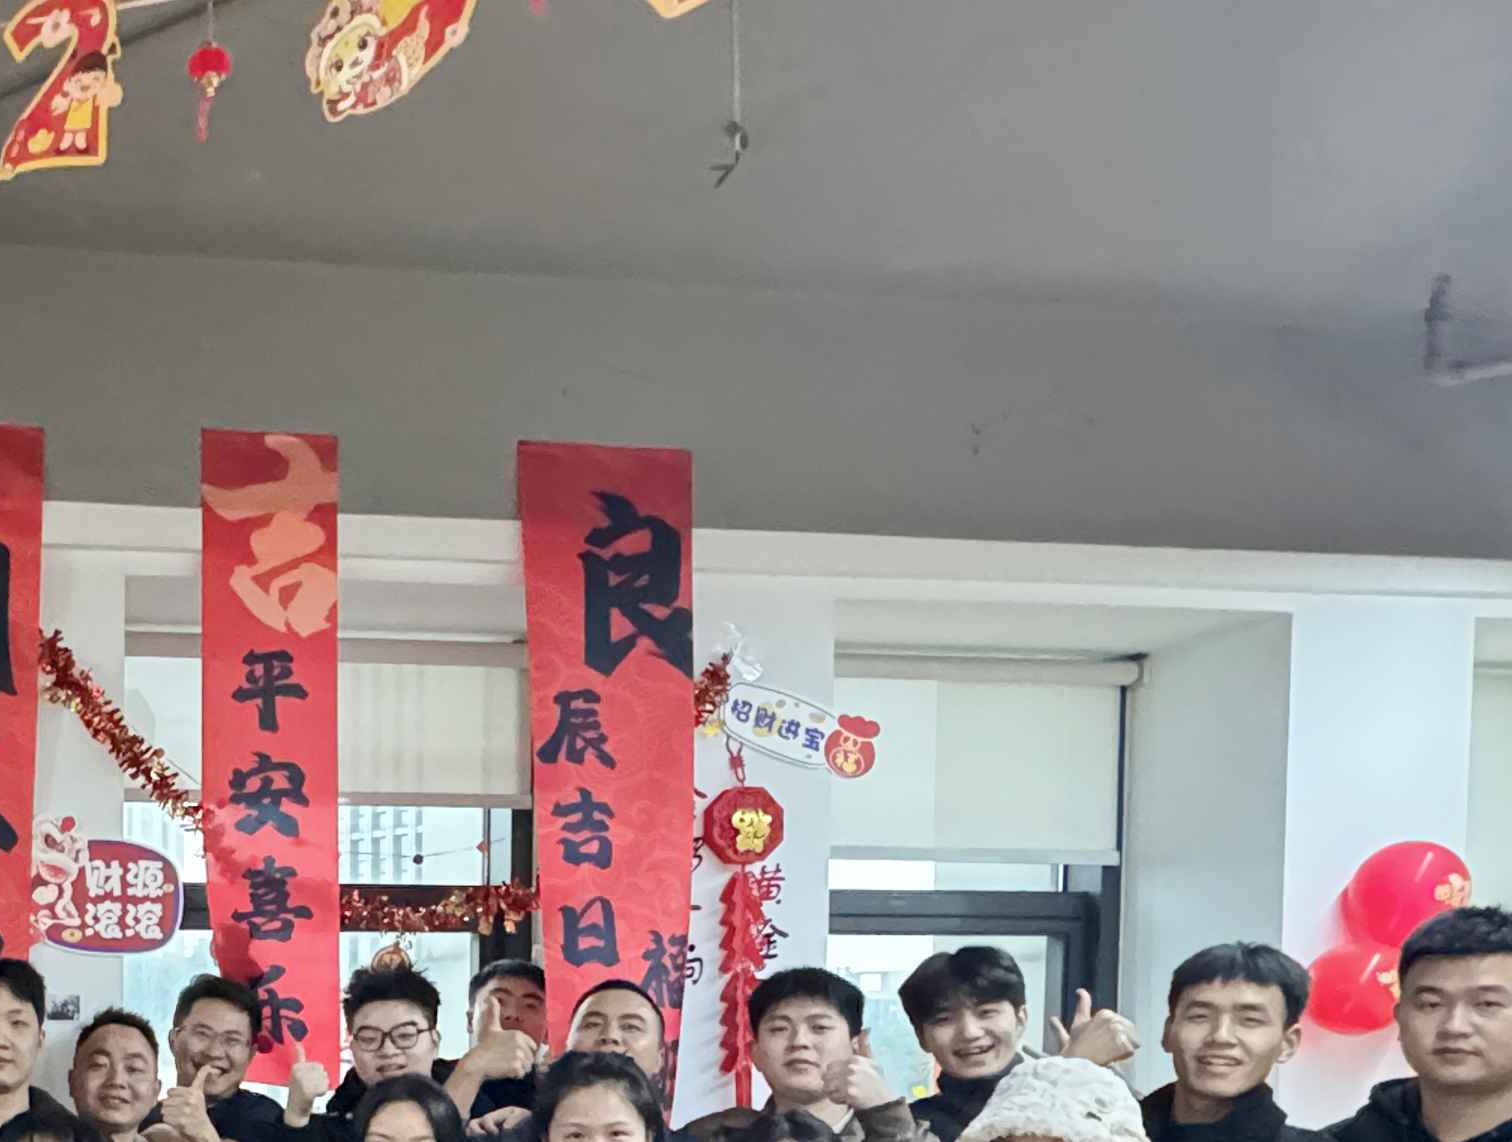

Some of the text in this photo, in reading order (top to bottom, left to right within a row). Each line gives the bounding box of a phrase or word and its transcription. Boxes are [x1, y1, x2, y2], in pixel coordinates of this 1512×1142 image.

[730, 698, 826, 752] 招财进宝
[86, 859, 165, 897] 财源
[84, 900, 164, 940] 滚滚
